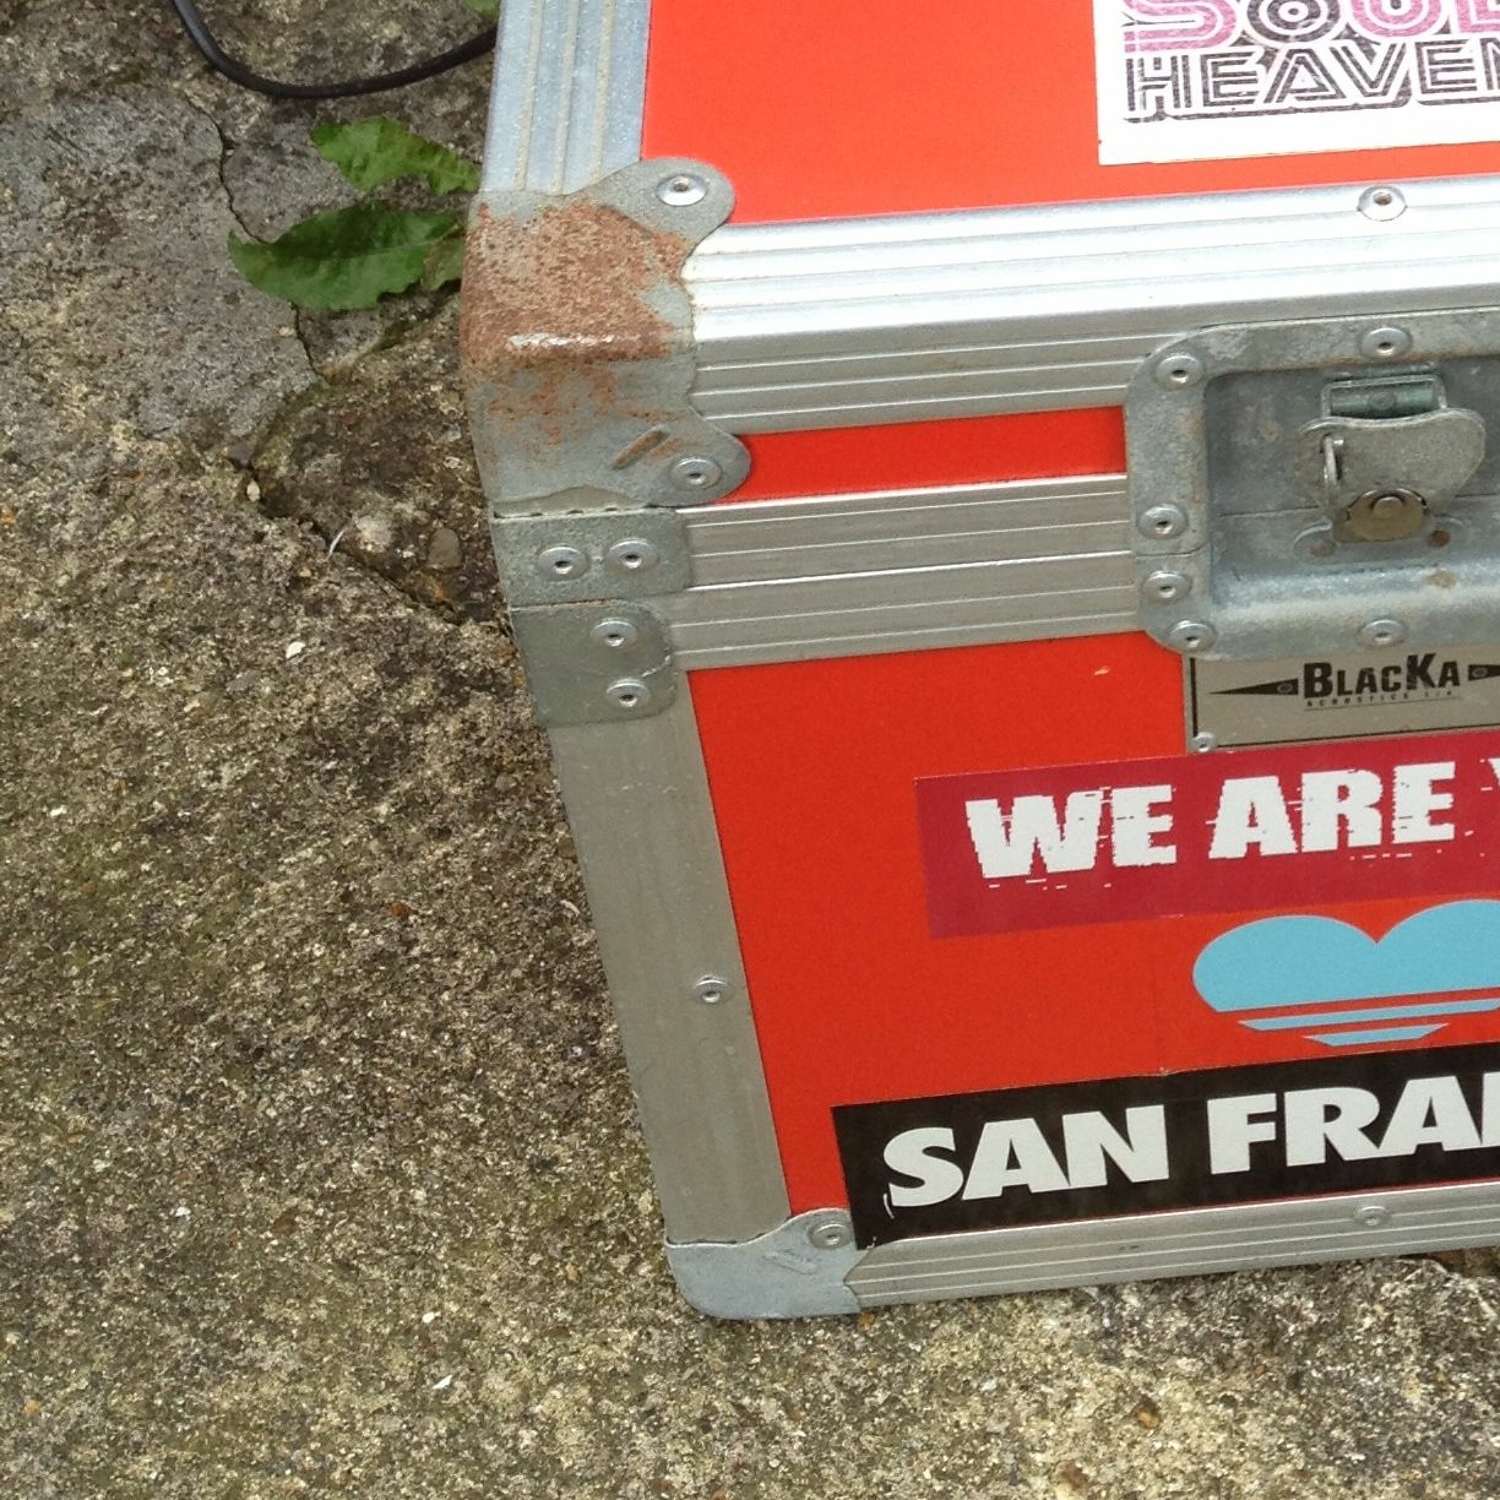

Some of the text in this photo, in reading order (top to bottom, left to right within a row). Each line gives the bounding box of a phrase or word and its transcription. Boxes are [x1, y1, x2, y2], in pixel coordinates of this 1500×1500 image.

[966, 784, 1177, 881] WE
[1208, 761, 1458, 861] ARE
[884, 1106, 1169, 1207] SAN
